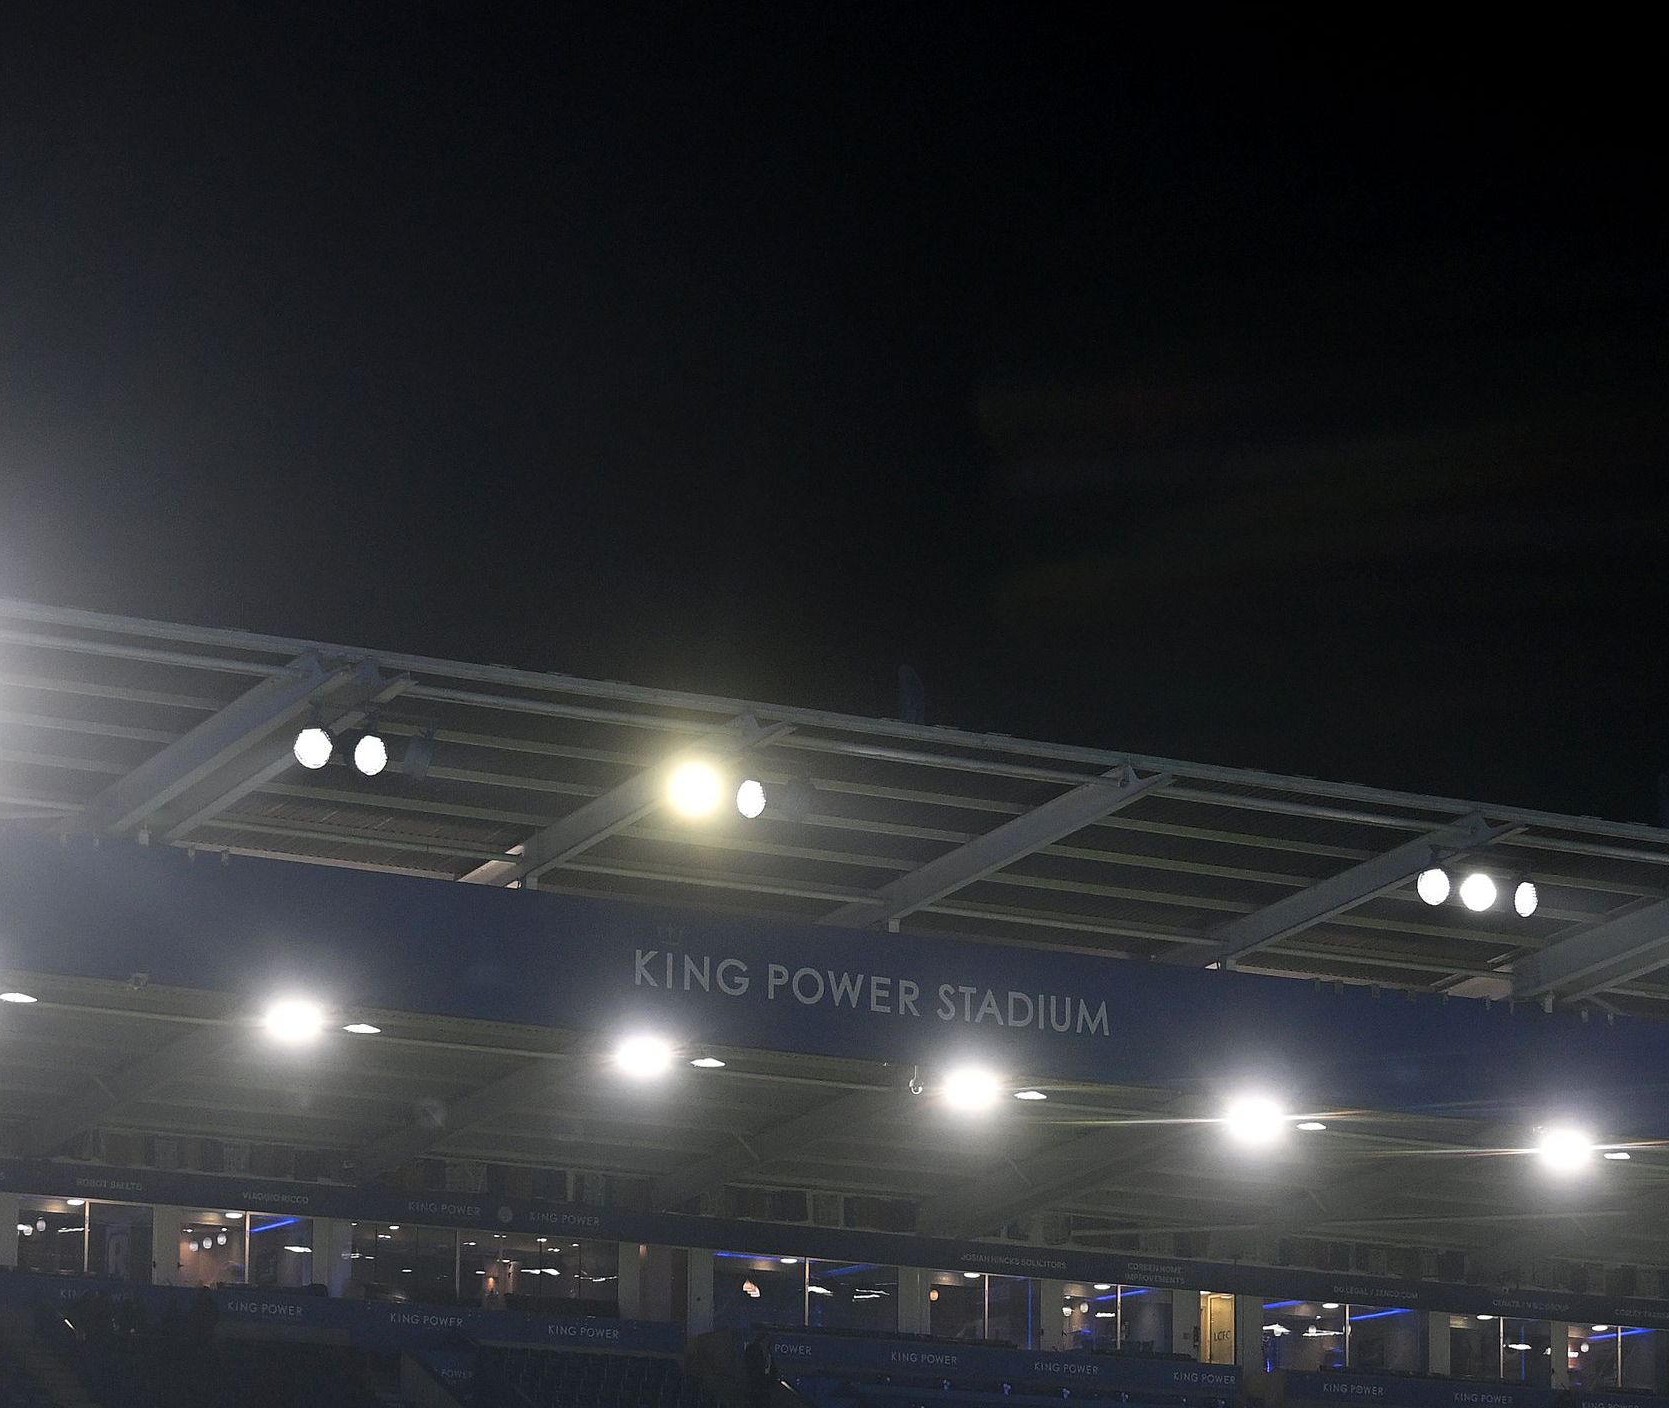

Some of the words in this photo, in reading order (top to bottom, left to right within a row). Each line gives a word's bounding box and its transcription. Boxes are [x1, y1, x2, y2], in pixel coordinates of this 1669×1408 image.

[635, 949, 750, 997] KING
[767, 963, 920, 1017] POWER
[937, 984, 1110, 1037] STADIUM
[408, 1201, 438, 1214] KING
[441, 1203, 481, 1217] POWER
[529, 1211, 558, 1224] KING
[562, 1213, 600, 1227] POWER
[227, 1301, 258, 1313] KING
[261, 1303, 303, 1317] POWER
[389, 1313, 420, 1325] KING
[423, 1315, 464, 1328] POWER
[547, 1325, 577, 1337] KING
[580, 1326, 620, 1339] POWER
[774, 1343, 813, 1356] POWER
[891, 1351, 919, 1363] KING
[921, 1353, 958, 1366] POWER
[1034, 1361, 1061, 1373] KING
[1063, 1363, 1099, 1376] POWER
[1173, 1371, 1199, 1383] KING
[1201, 1373, 1237, 1385] POWER
[1323, 1383, 1348, 1394] KING
[1350, 1385, 1385, 1396] POWER
[1454, 1393, 1478, 1404] KING
[1480, 1394, 1514, 1405] POWER
